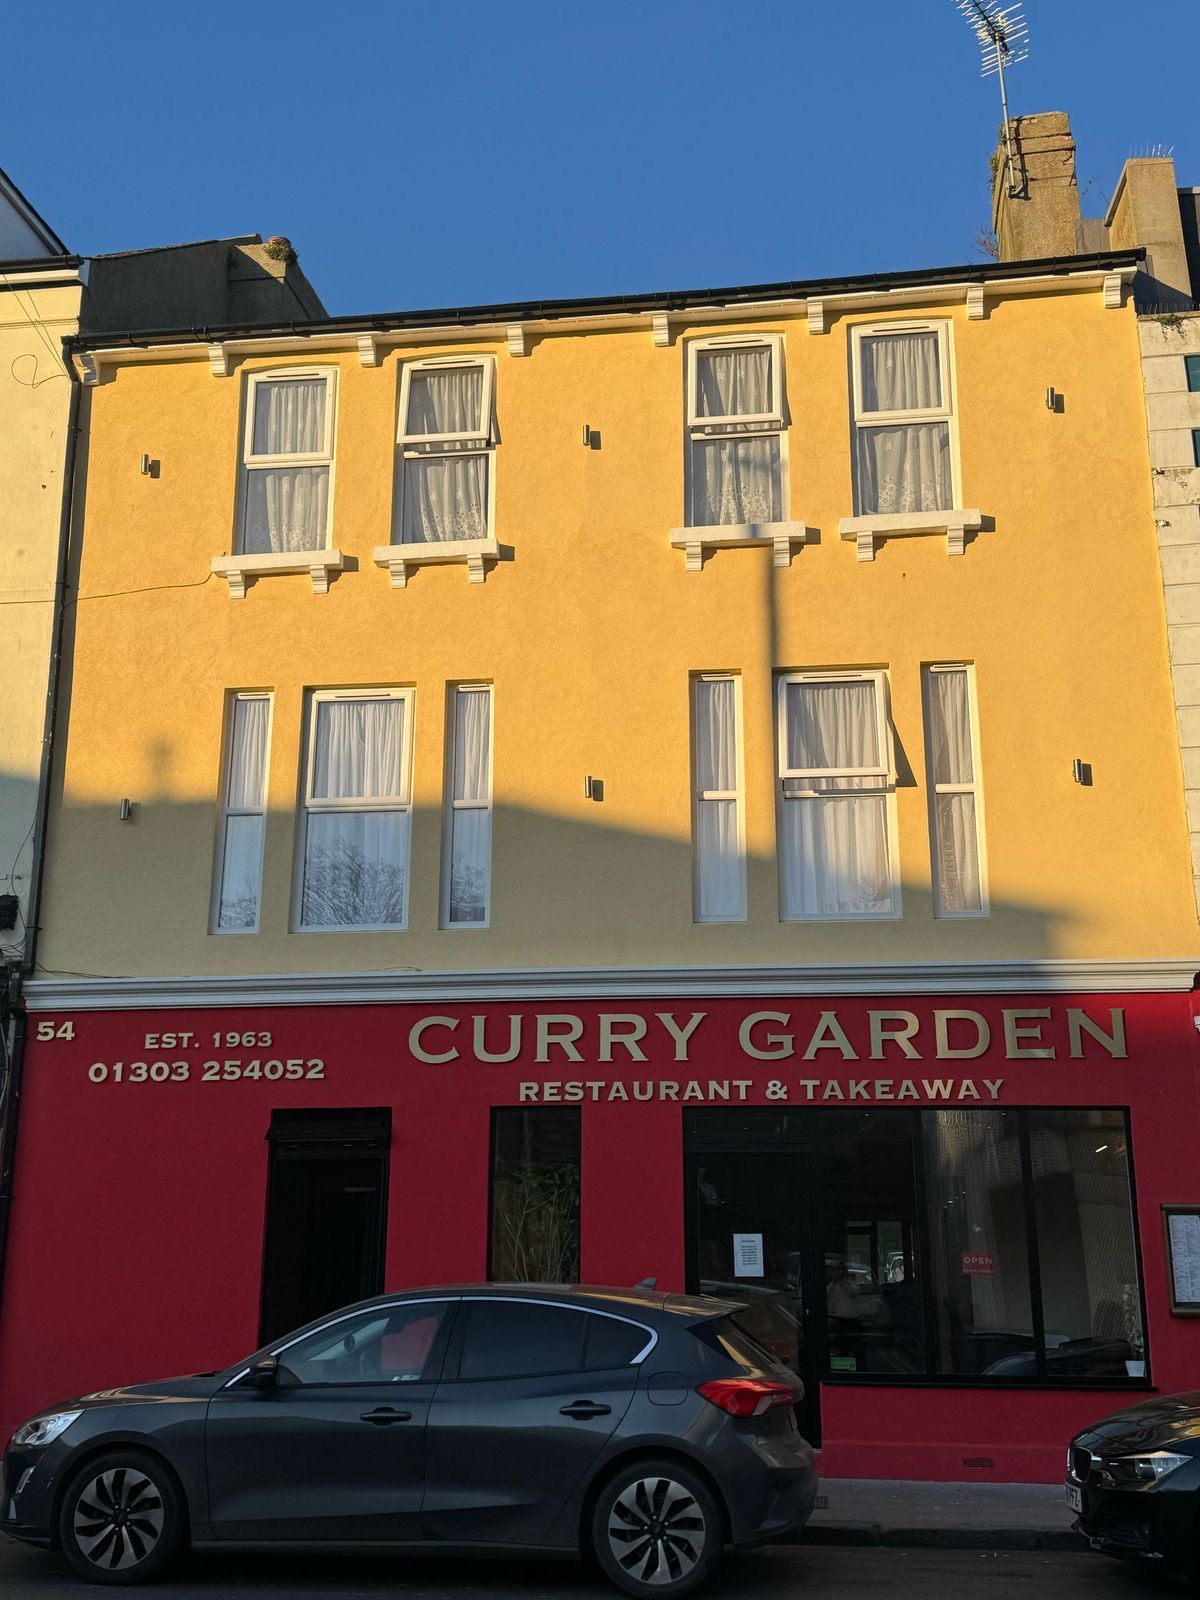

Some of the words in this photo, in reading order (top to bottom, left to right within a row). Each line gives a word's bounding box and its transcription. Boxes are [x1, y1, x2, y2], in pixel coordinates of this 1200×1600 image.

[36, 1021, 76, 1042] 54
[144, 1032, 200, 1049] EST.
[212, 1031, 273, 1048] 1963
[408, 1012, 708, 1064] CURRY
[738, 1007, 1129, 1060] GARDEN
[88, 1061, 190, 1083] 01303
[201, 1058, 325, 1081] 254052
[519, 1079, 753, 1102] RESTAURANT
[765, 1079, 788, 1100] &
[799, 1078, 1005, 1100] TAKEAWAY
[963, 1256, 993, 1265] OPEN
